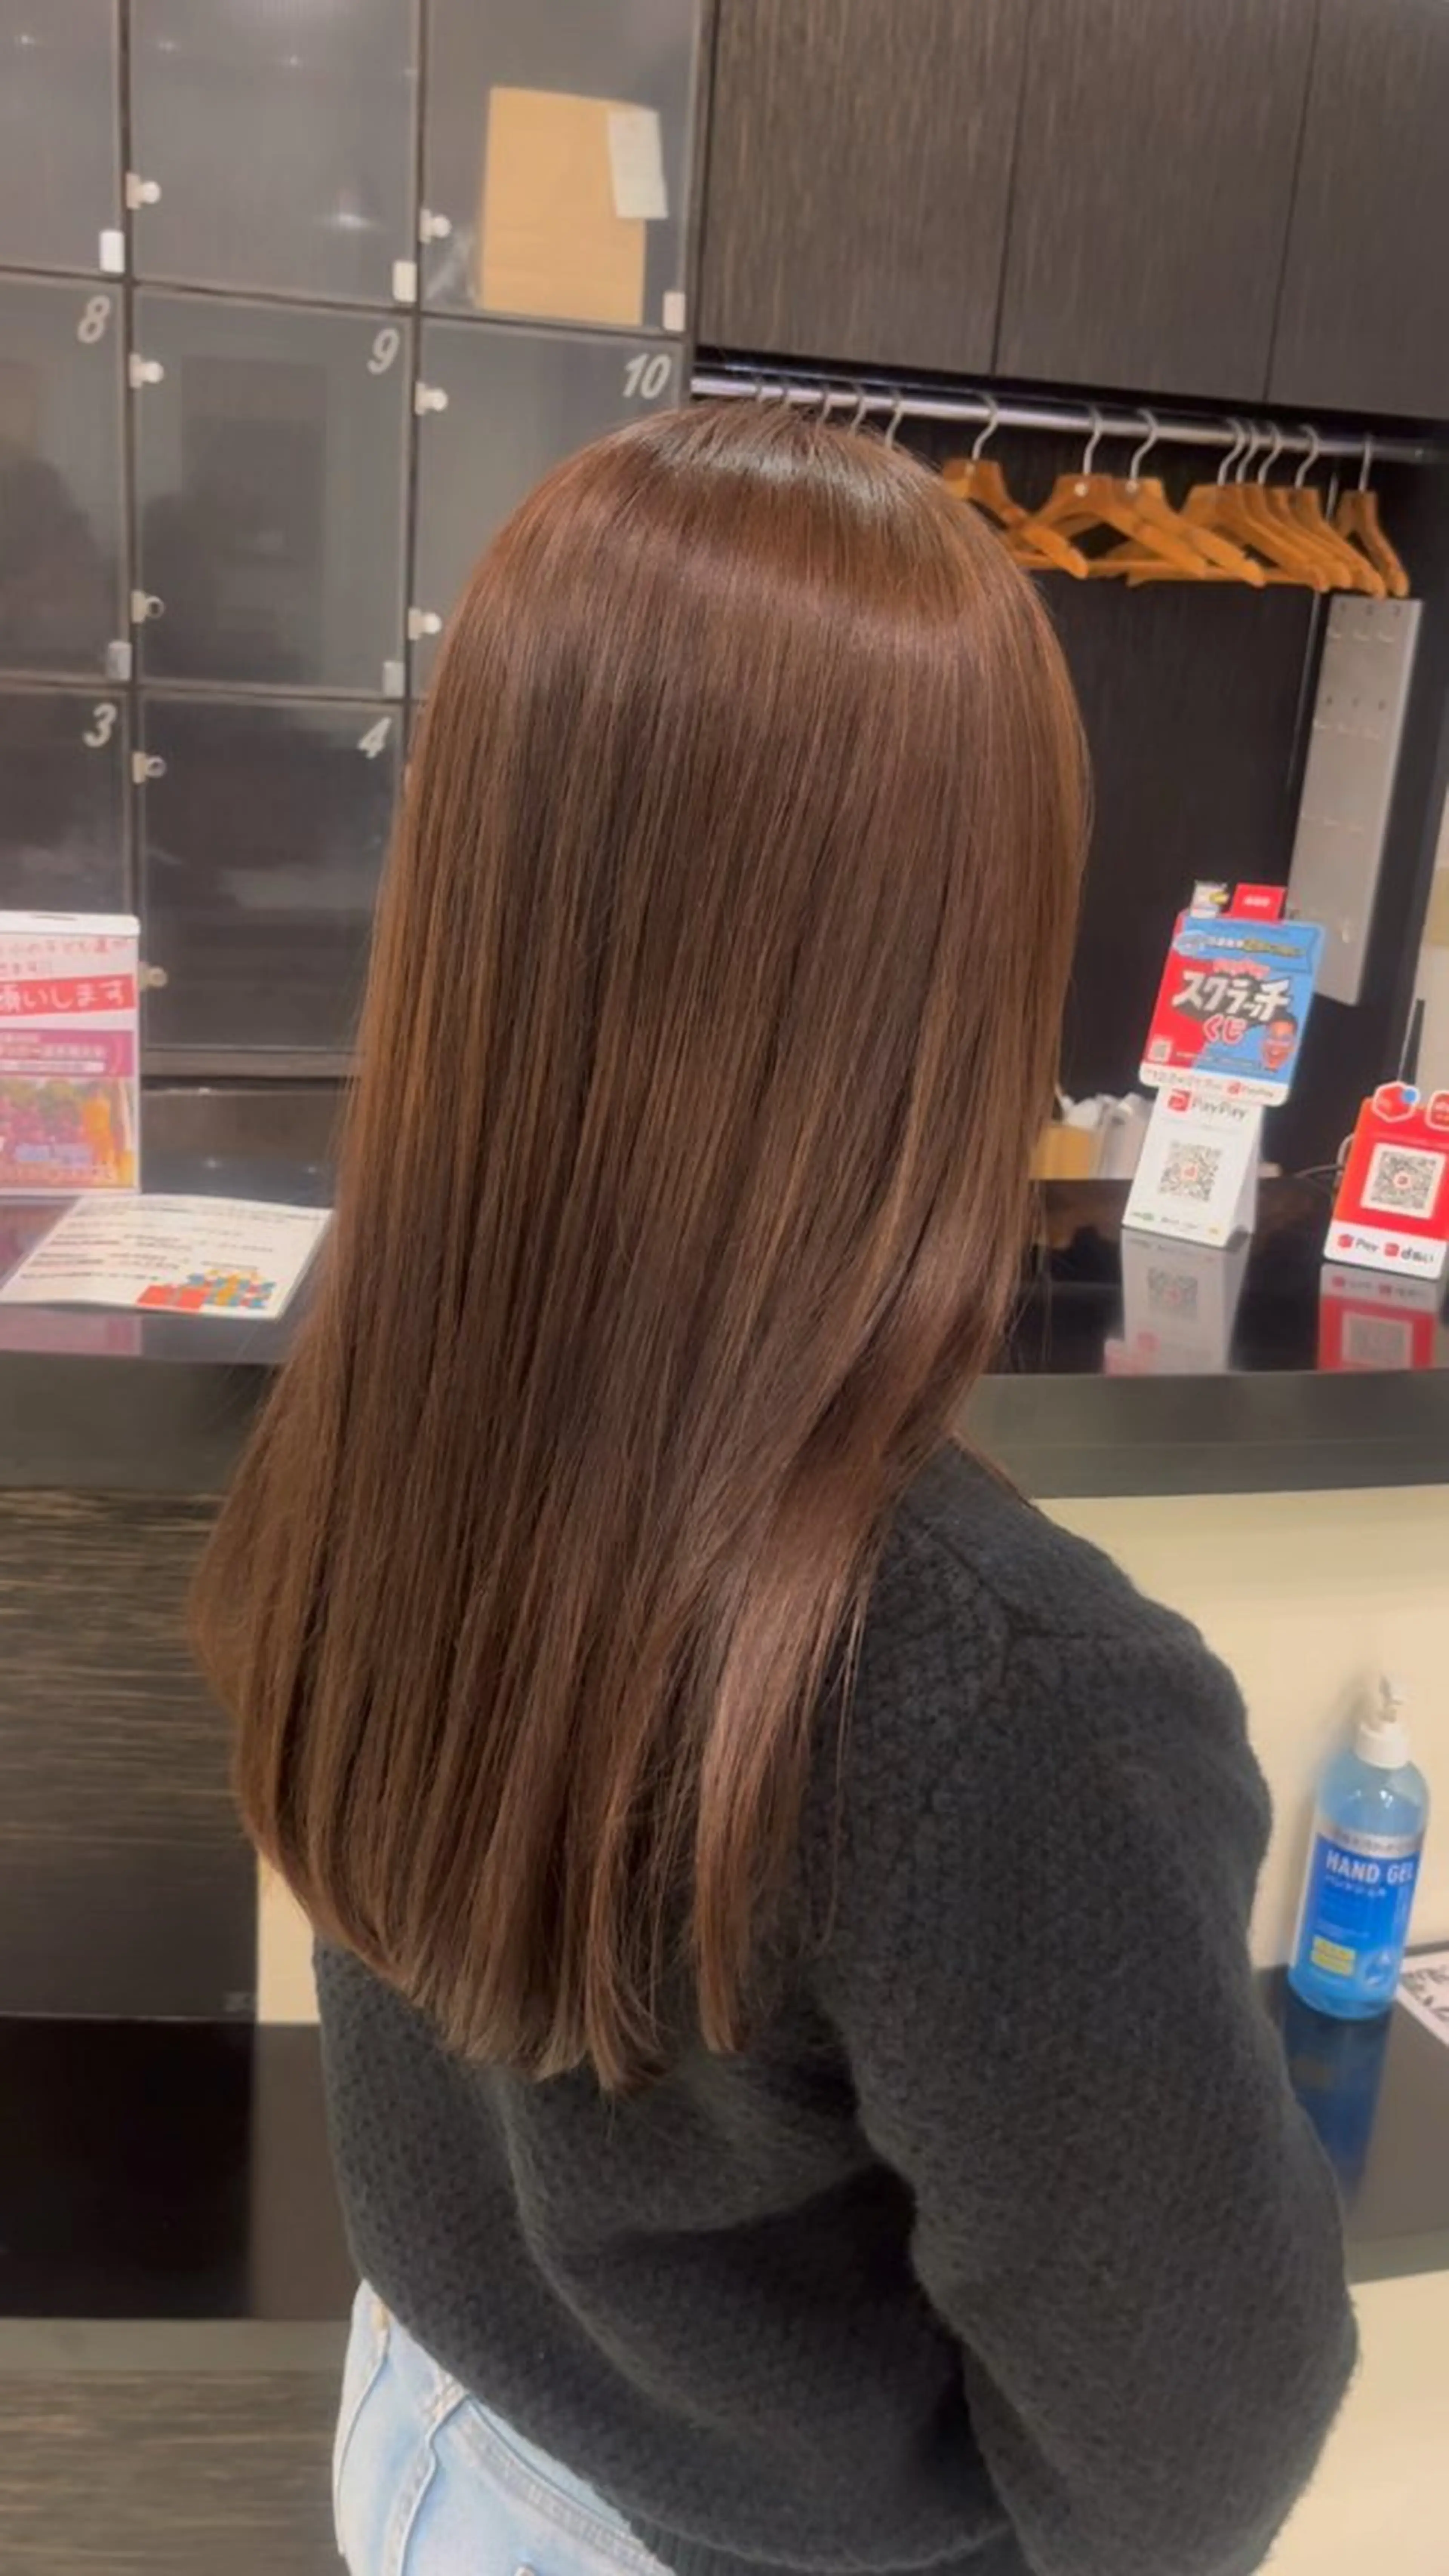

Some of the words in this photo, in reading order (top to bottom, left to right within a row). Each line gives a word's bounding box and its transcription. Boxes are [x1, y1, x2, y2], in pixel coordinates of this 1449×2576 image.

[78, 295, 110, 343] 8
[367, 328, 400, 374] 9
[623, 353, 671, 399] 10
[82, 703, 117, 747] 3
[357, 716, 392, 760] 4
[1172, 970, 1291, 1021] スクラッチ
[1203, 1013, 1247, 1045] くじ
[1191, 1095, 1249, 1121] PayPay
[1326, 1849, 1381, 1885] HAND
